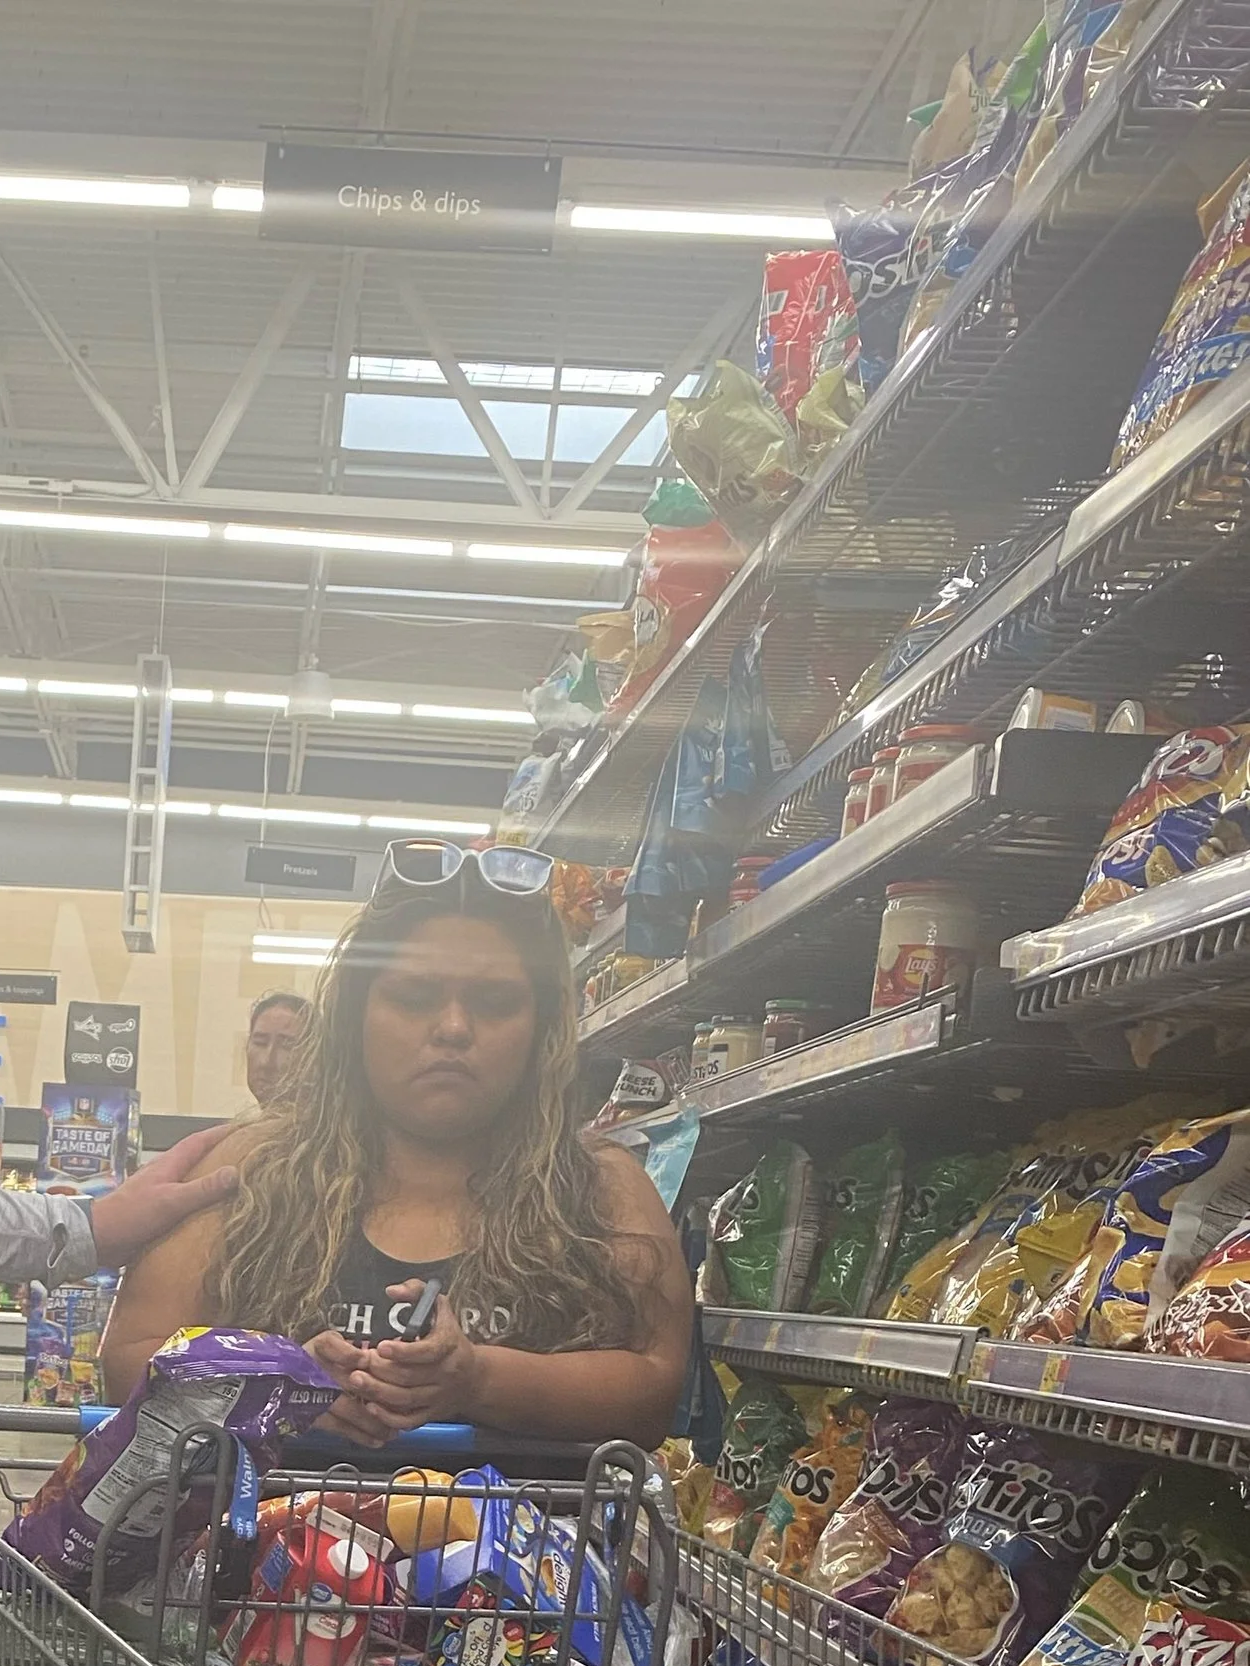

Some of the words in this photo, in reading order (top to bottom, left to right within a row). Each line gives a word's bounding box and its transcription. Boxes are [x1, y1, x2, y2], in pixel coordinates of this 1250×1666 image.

[337, 185, 402, 216] Chips
[410, 189, 426, 212] &
[434, 192, 481, 220] dips
[55, 1127, 92, 1141] TASTE
[94, 1130, 111, 1142] OF
[52, 1140, 111, 1157] GAMEDAY
